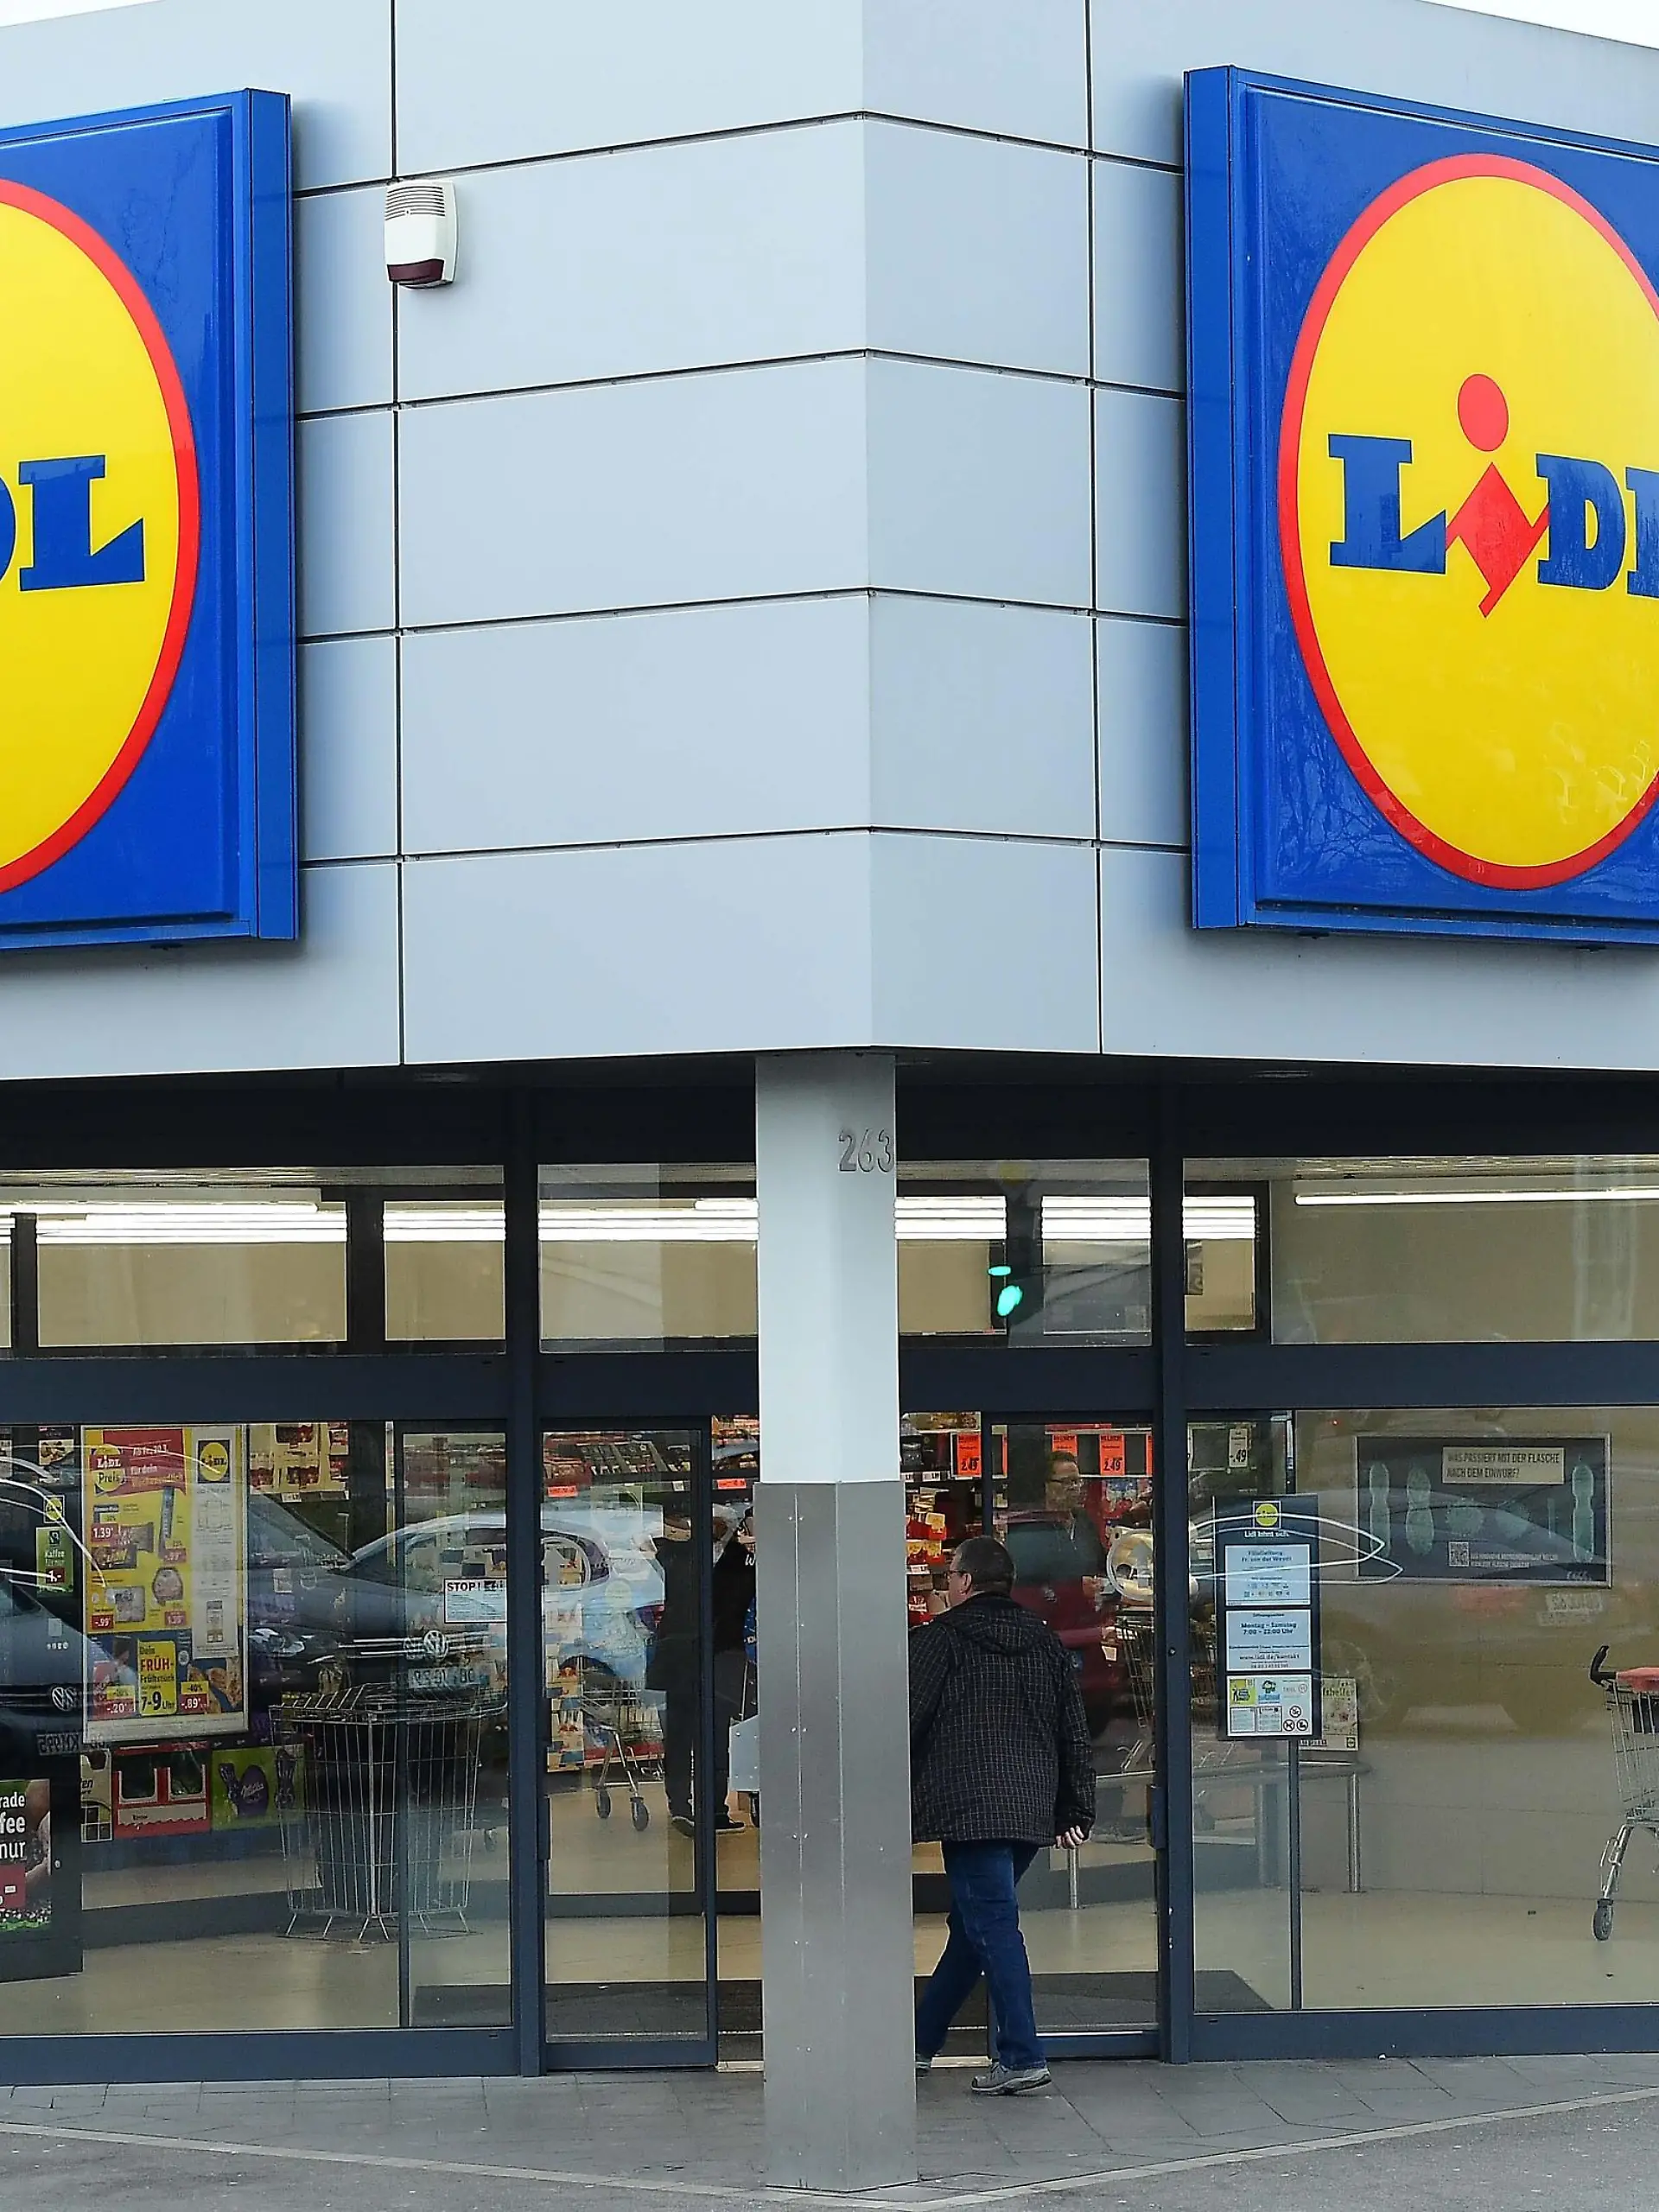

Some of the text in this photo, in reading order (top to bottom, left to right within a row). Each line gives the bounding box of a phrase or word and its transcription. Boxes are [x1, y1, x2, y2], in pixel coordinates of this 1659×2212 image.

[0, 454, 145, 592] L
[838, 1126, 893, 1173] 263
[1230, 1449, 1247, 1463] -.49
[1528, 1453, 1560, 1463] FLASCHE
[99, 1471, 120, 1484] Preis
[141, 1656, 173, 1671] FRÜH-
